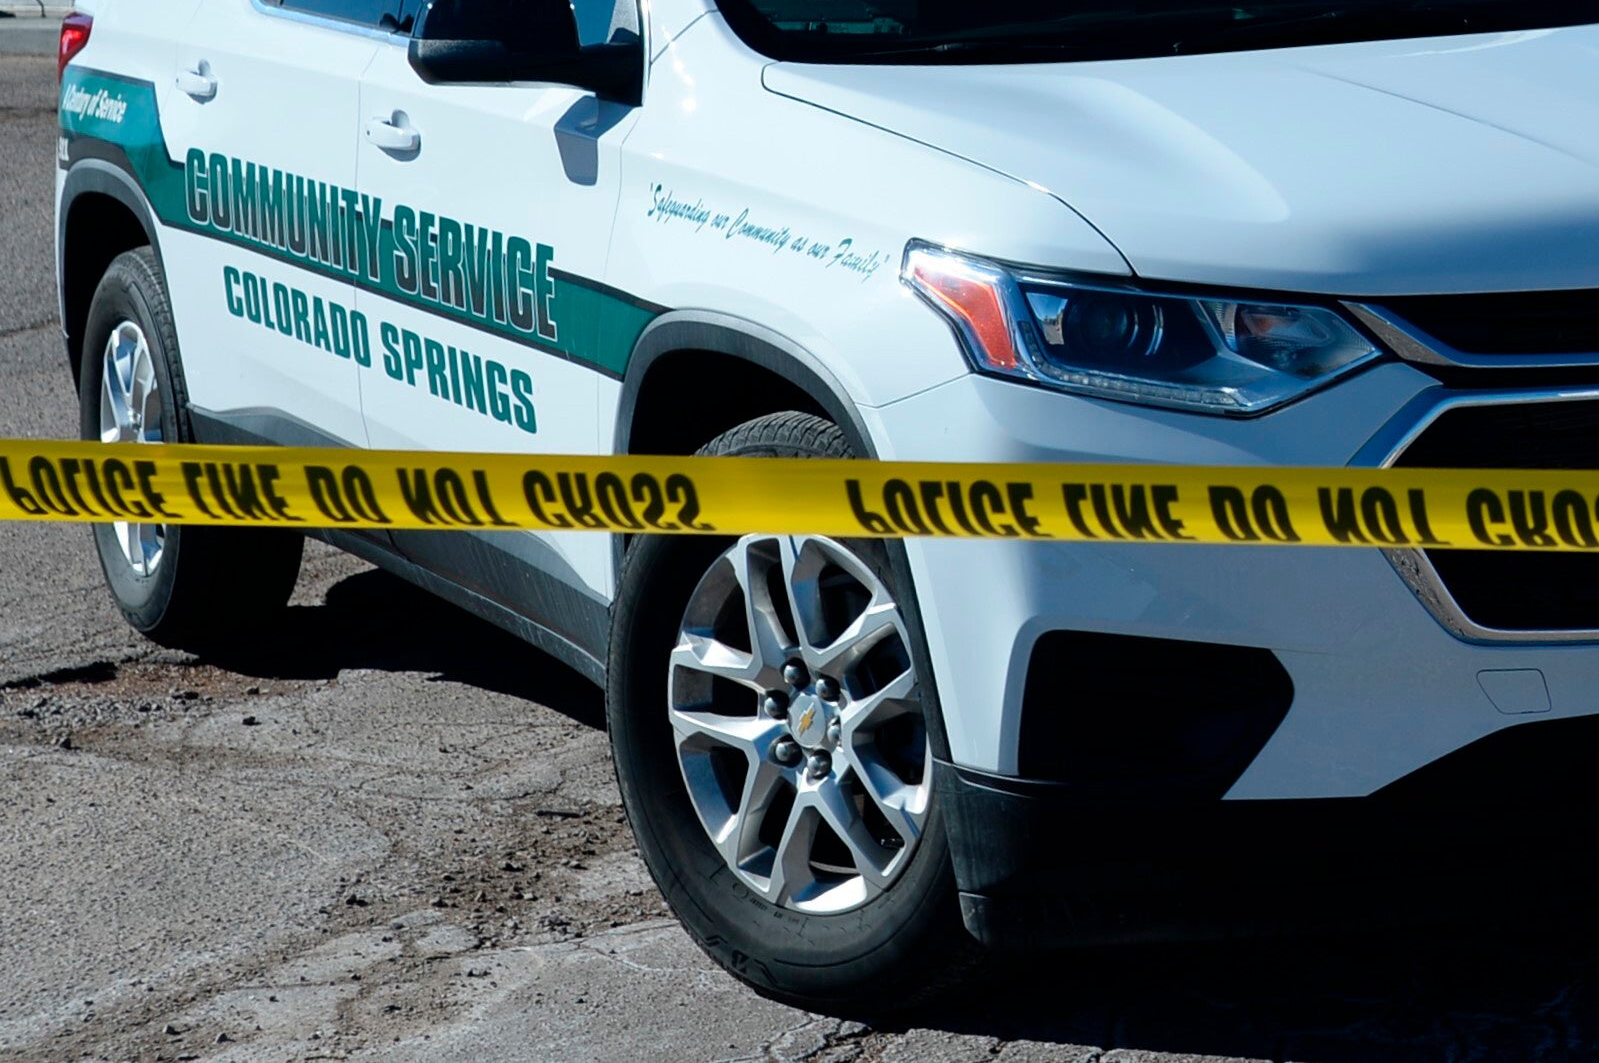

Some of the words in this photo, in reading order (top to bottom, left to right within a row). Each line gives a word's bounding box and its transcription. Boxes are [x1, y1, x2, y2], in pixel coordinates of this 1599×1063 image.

[95, 90, 127, 123] Service
[185, 147, 382, 283] COMMUNITY
[392, 204, 558, 342] SERVICE
[711, 213, 730, 231] our
[726, 208, 792, 255] Community
[790, 236, 806, 252] as
[806, 242, 831, 259] our
[223, 265, 371, 368] COLORADO
[380, 321, 537, 435] SPRINGS
